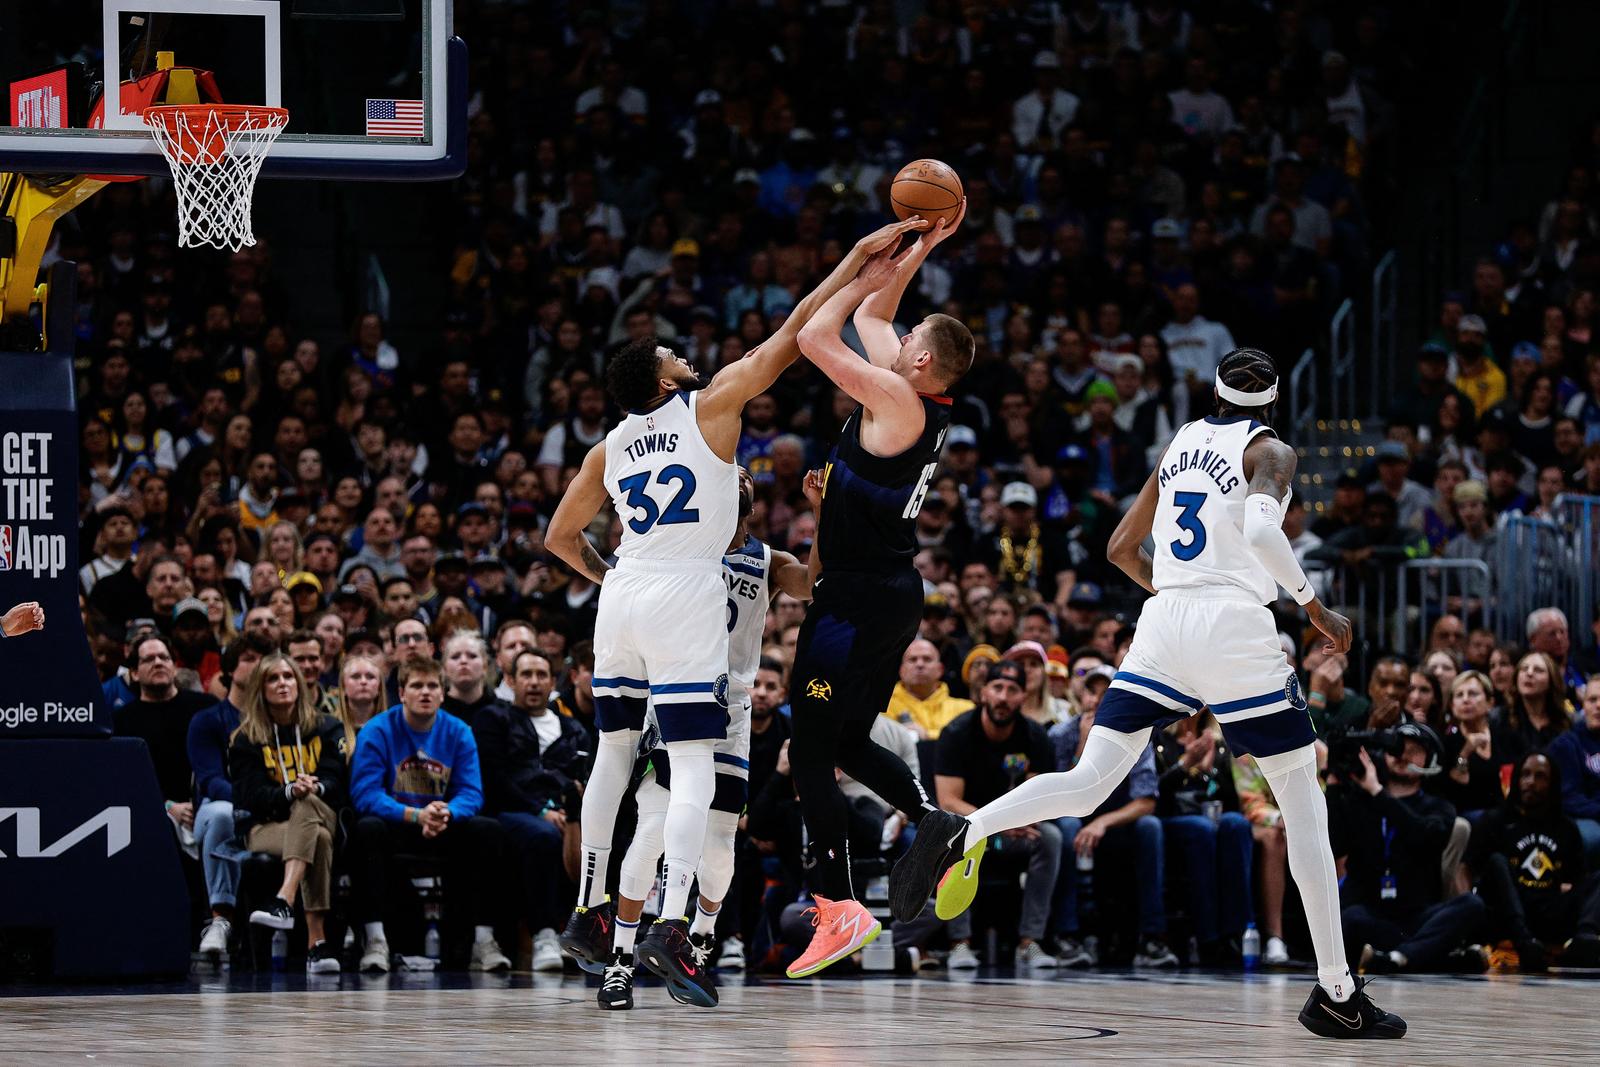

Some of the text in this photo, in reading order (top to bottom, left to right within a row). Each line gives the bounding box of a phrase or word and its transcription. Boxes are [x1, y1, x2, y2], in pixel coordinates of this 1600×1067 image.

[2, 431, 53, 475] GET
[624, 433, 679, 462] TOWNS
[2, 477, 54, 521] THE
[618, 464, 700, 535] 32
[902, 462, 938, 519] 15
[1170, 490, 1208, 562] 3
[15, 525, 66, 579] App
[44, 702, 94, 723] Pixel
